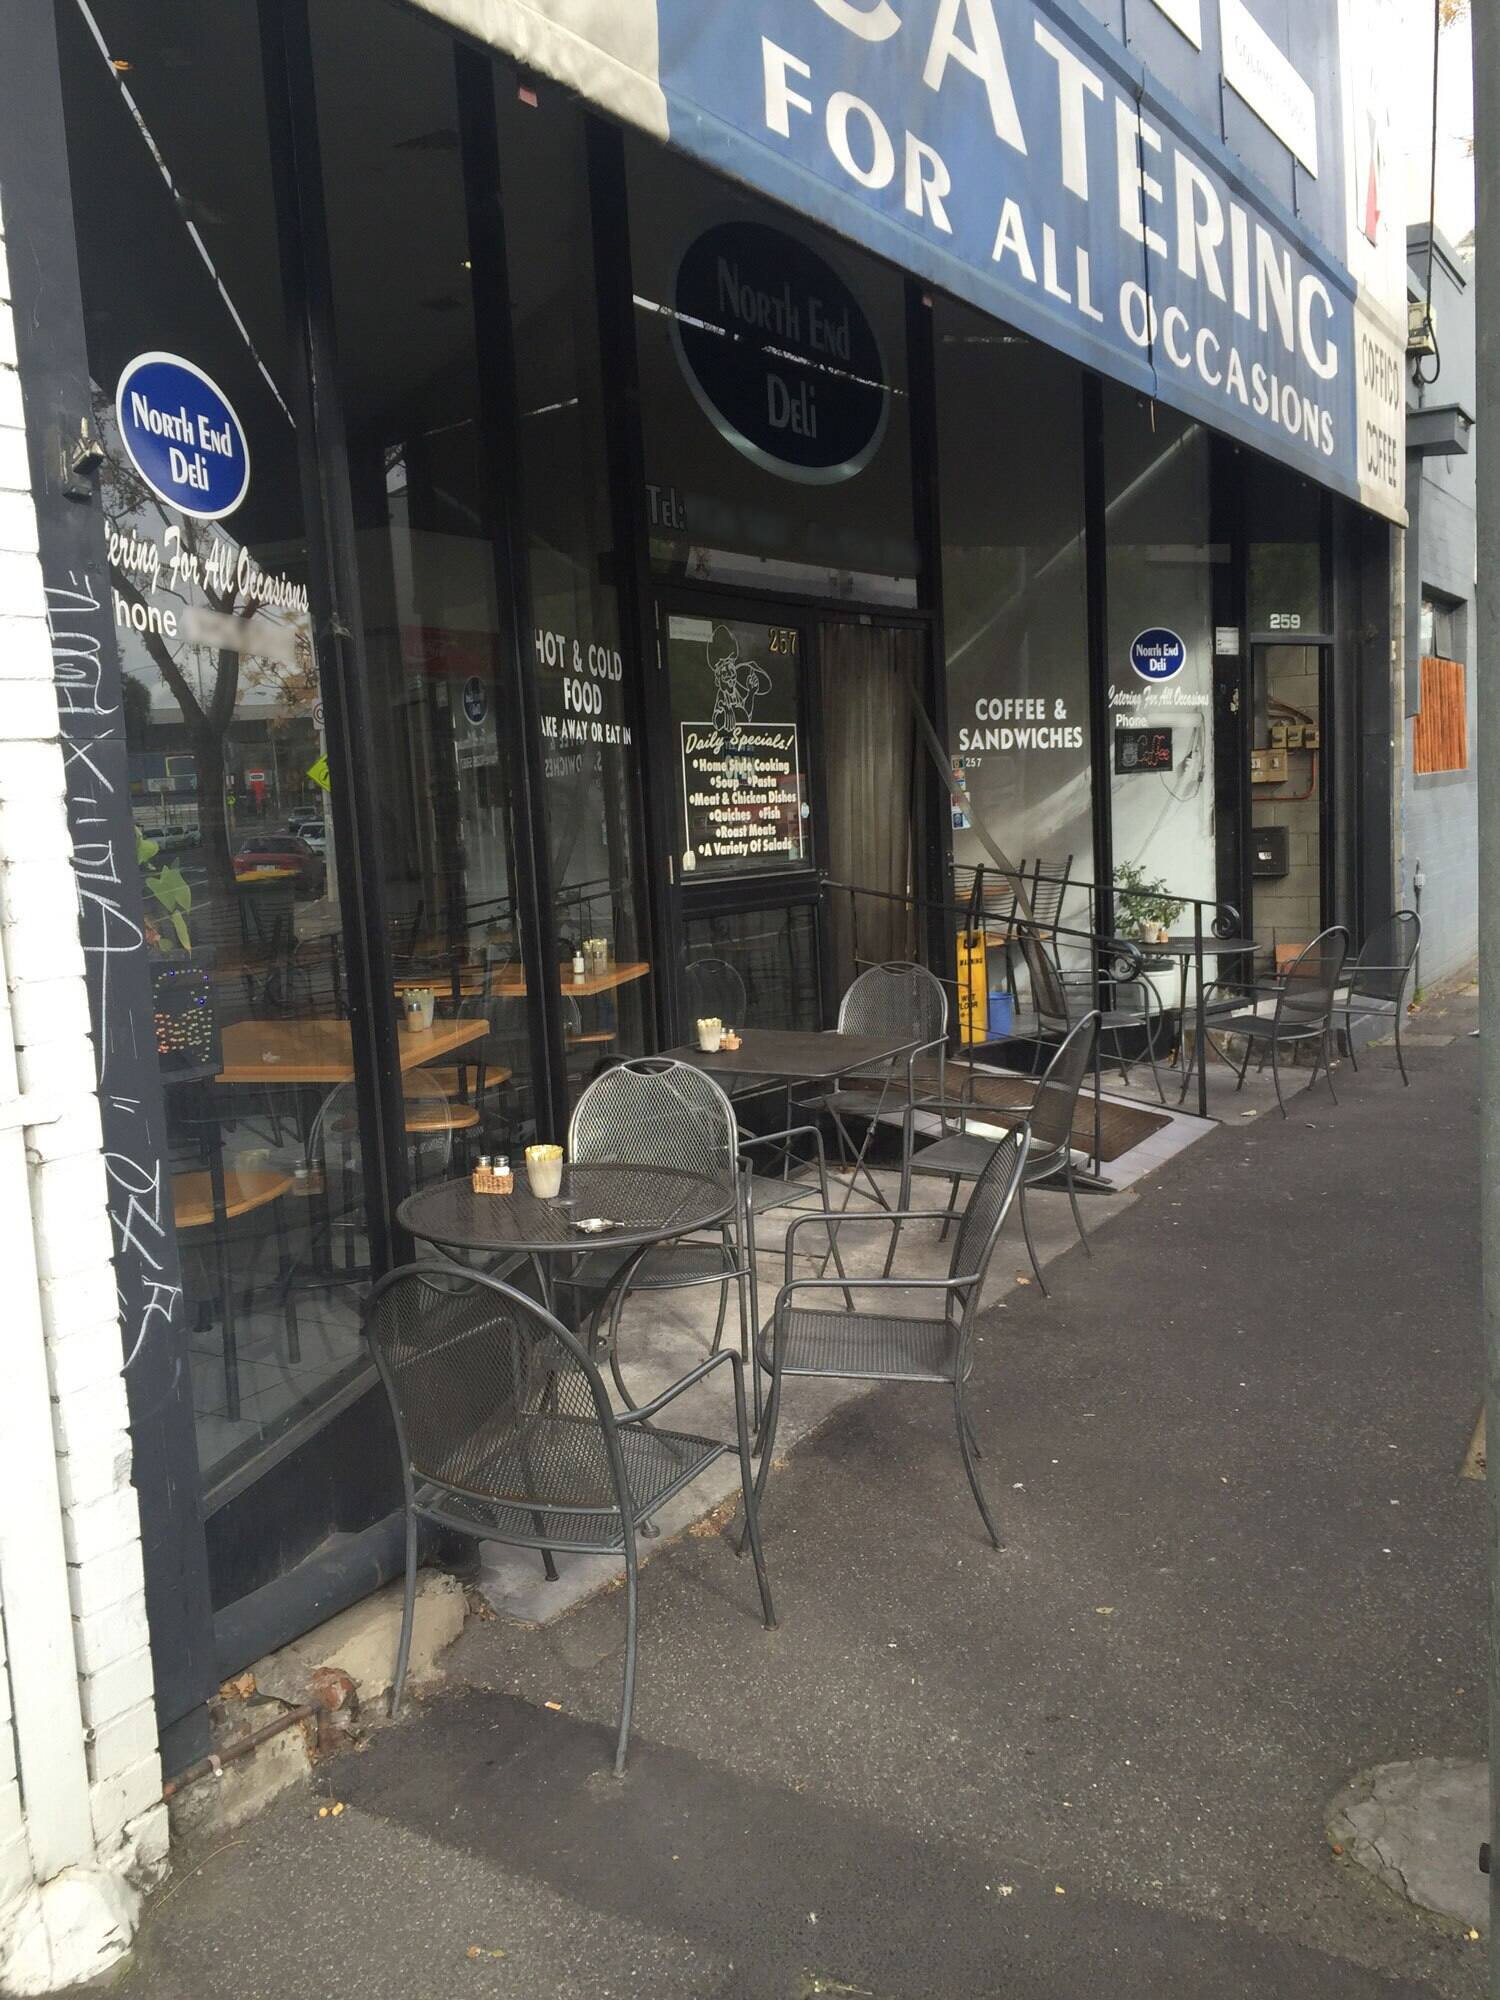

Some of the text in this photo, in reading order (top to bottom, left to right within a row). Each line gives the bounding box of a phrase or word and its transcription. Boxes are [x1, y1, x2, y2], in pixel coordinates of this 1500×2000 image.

[762, 35, 1335, 456] FOR ALL OCCASIONS
[1366, 420, 1396, 488] COFFEE
[164, 525, 200, 591] For
[203, 537, 235, 593] All
[237, 546, 309, 613] Occasions
[111, 586, 177, 637] hone
[1269, 613, 1301, 629] 259
[769, 627, 797, 655] 257
[535, 628, 623, 681] HOT & COLD
[563, 677, 602, 715] FOOD
[1158, 687, 1173, 707] All
[1173, 687, 1209, 707] Occasions
[975, 698, 1067, 720] COFFEE &
[561, 718, 588, 741] AWAY
[591, 722, 603, 743] OR
[605, 724, 620, 744] EAT
[623, 726, 632, 745] IN
[1115, 713, 1147, 728] Phone
[686, 730, 725, 754] Daily
[730, 727, 794, 751] Specials!
[959, 726, 1083, 751] SANDWICHES
[754, 758, 790, 774] Cooking
[965, 757, 982, 768] 257
[715, 775, 777, 790] Soup Pasta
[722, 792, 730, 805] &
[732, 791, 767, 804] Chicken
[768, 790, 797, 803] Dishes
[763, 806, 781, 819] Fish
[749, 824, 776, 837] Meats
[714, 841, 748, 856] Variety
[750, 840, 761, 853] Of
[763, 837, 793, 850] Salads
